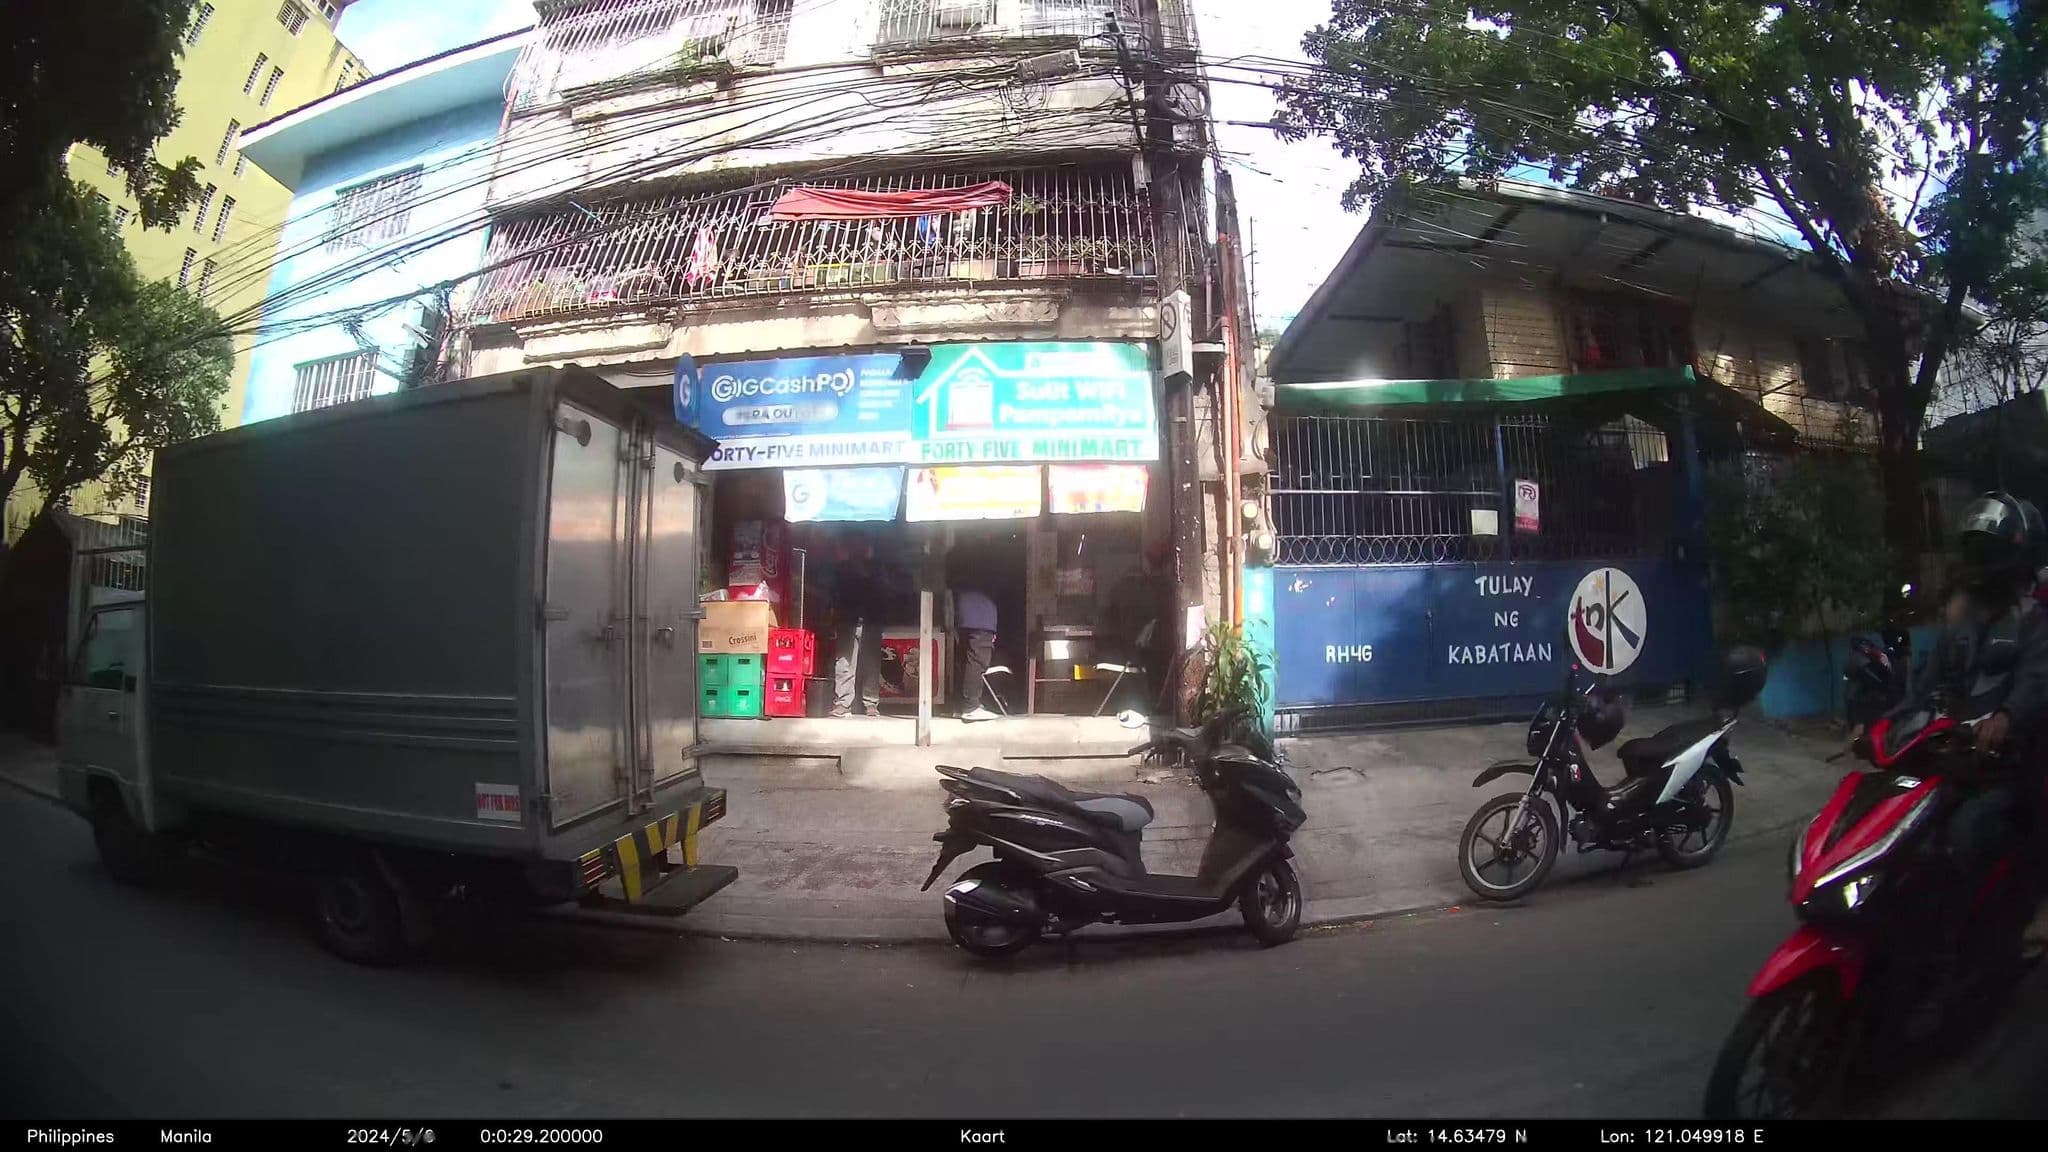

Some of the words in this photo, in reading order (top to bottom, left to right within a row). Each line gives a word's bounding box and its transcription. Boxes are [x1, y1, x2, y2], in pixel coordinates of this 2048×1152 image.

[711, 443, 804, 462] ORTY-FIVE
[809, 440, 905, 457] MINIMART
[922, 442, 973, 460] FORTY
[984, 441, 1019, 459] FIVE
[1033, 439, 1143, 458] MINIMART
[1475, 575, 1534, 597] TULAY
[1495, 611, 1520, 627] NG
[1325, 645, 1373, 662] RH4G
[1448, 643, 1552, 664] KABATAAN
